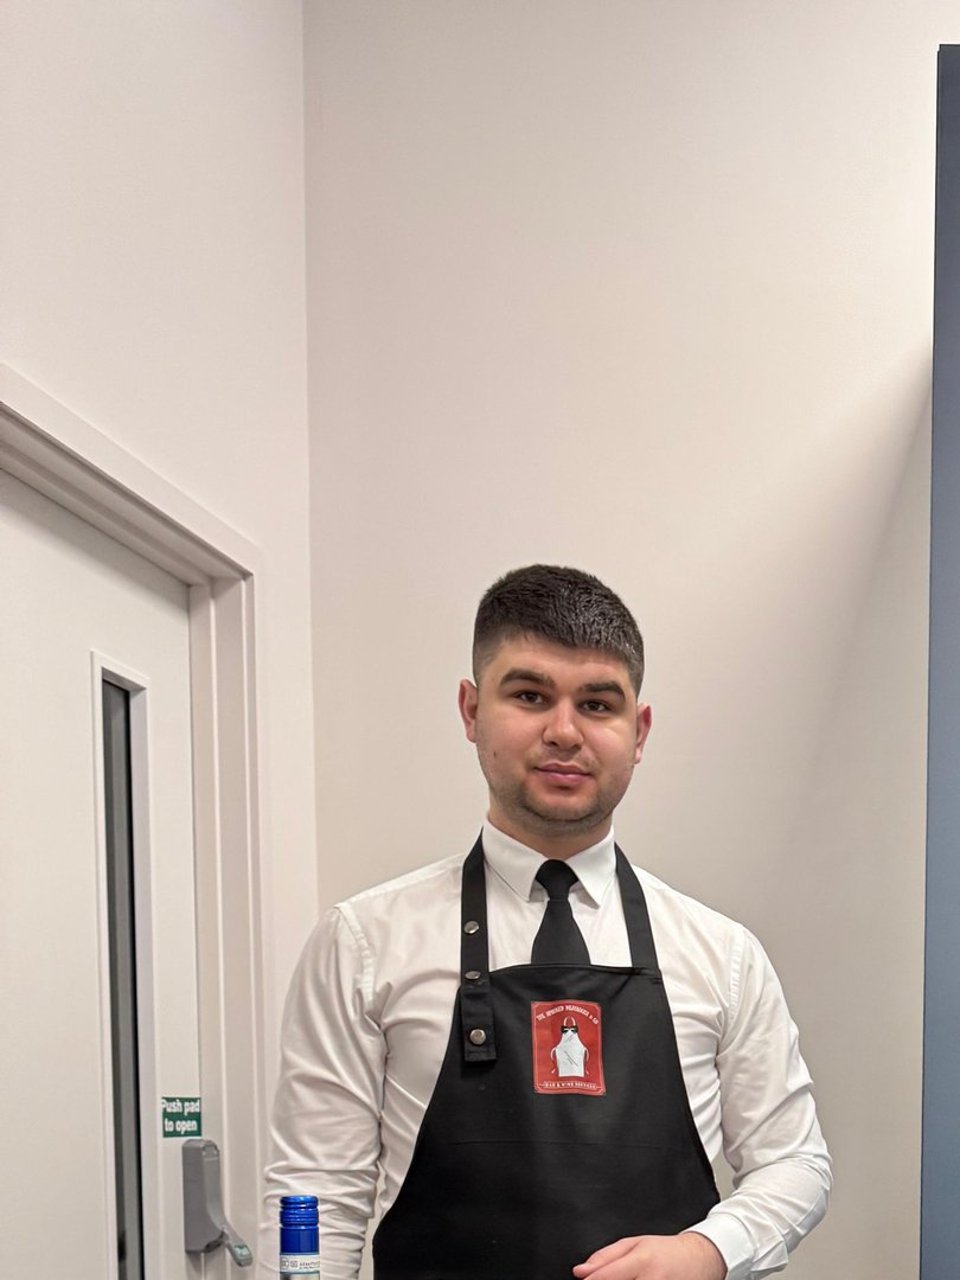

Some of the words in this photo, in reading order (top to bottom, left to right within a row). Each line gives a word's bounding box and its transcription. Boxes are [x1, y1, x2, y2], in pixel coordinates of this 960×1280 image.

[161, 1099, 183, 1113] Push
[184, 1099, 200, 1116] pad
[164, 1118, 174, 1132] to
[175, 1120, 198, 1135] open
